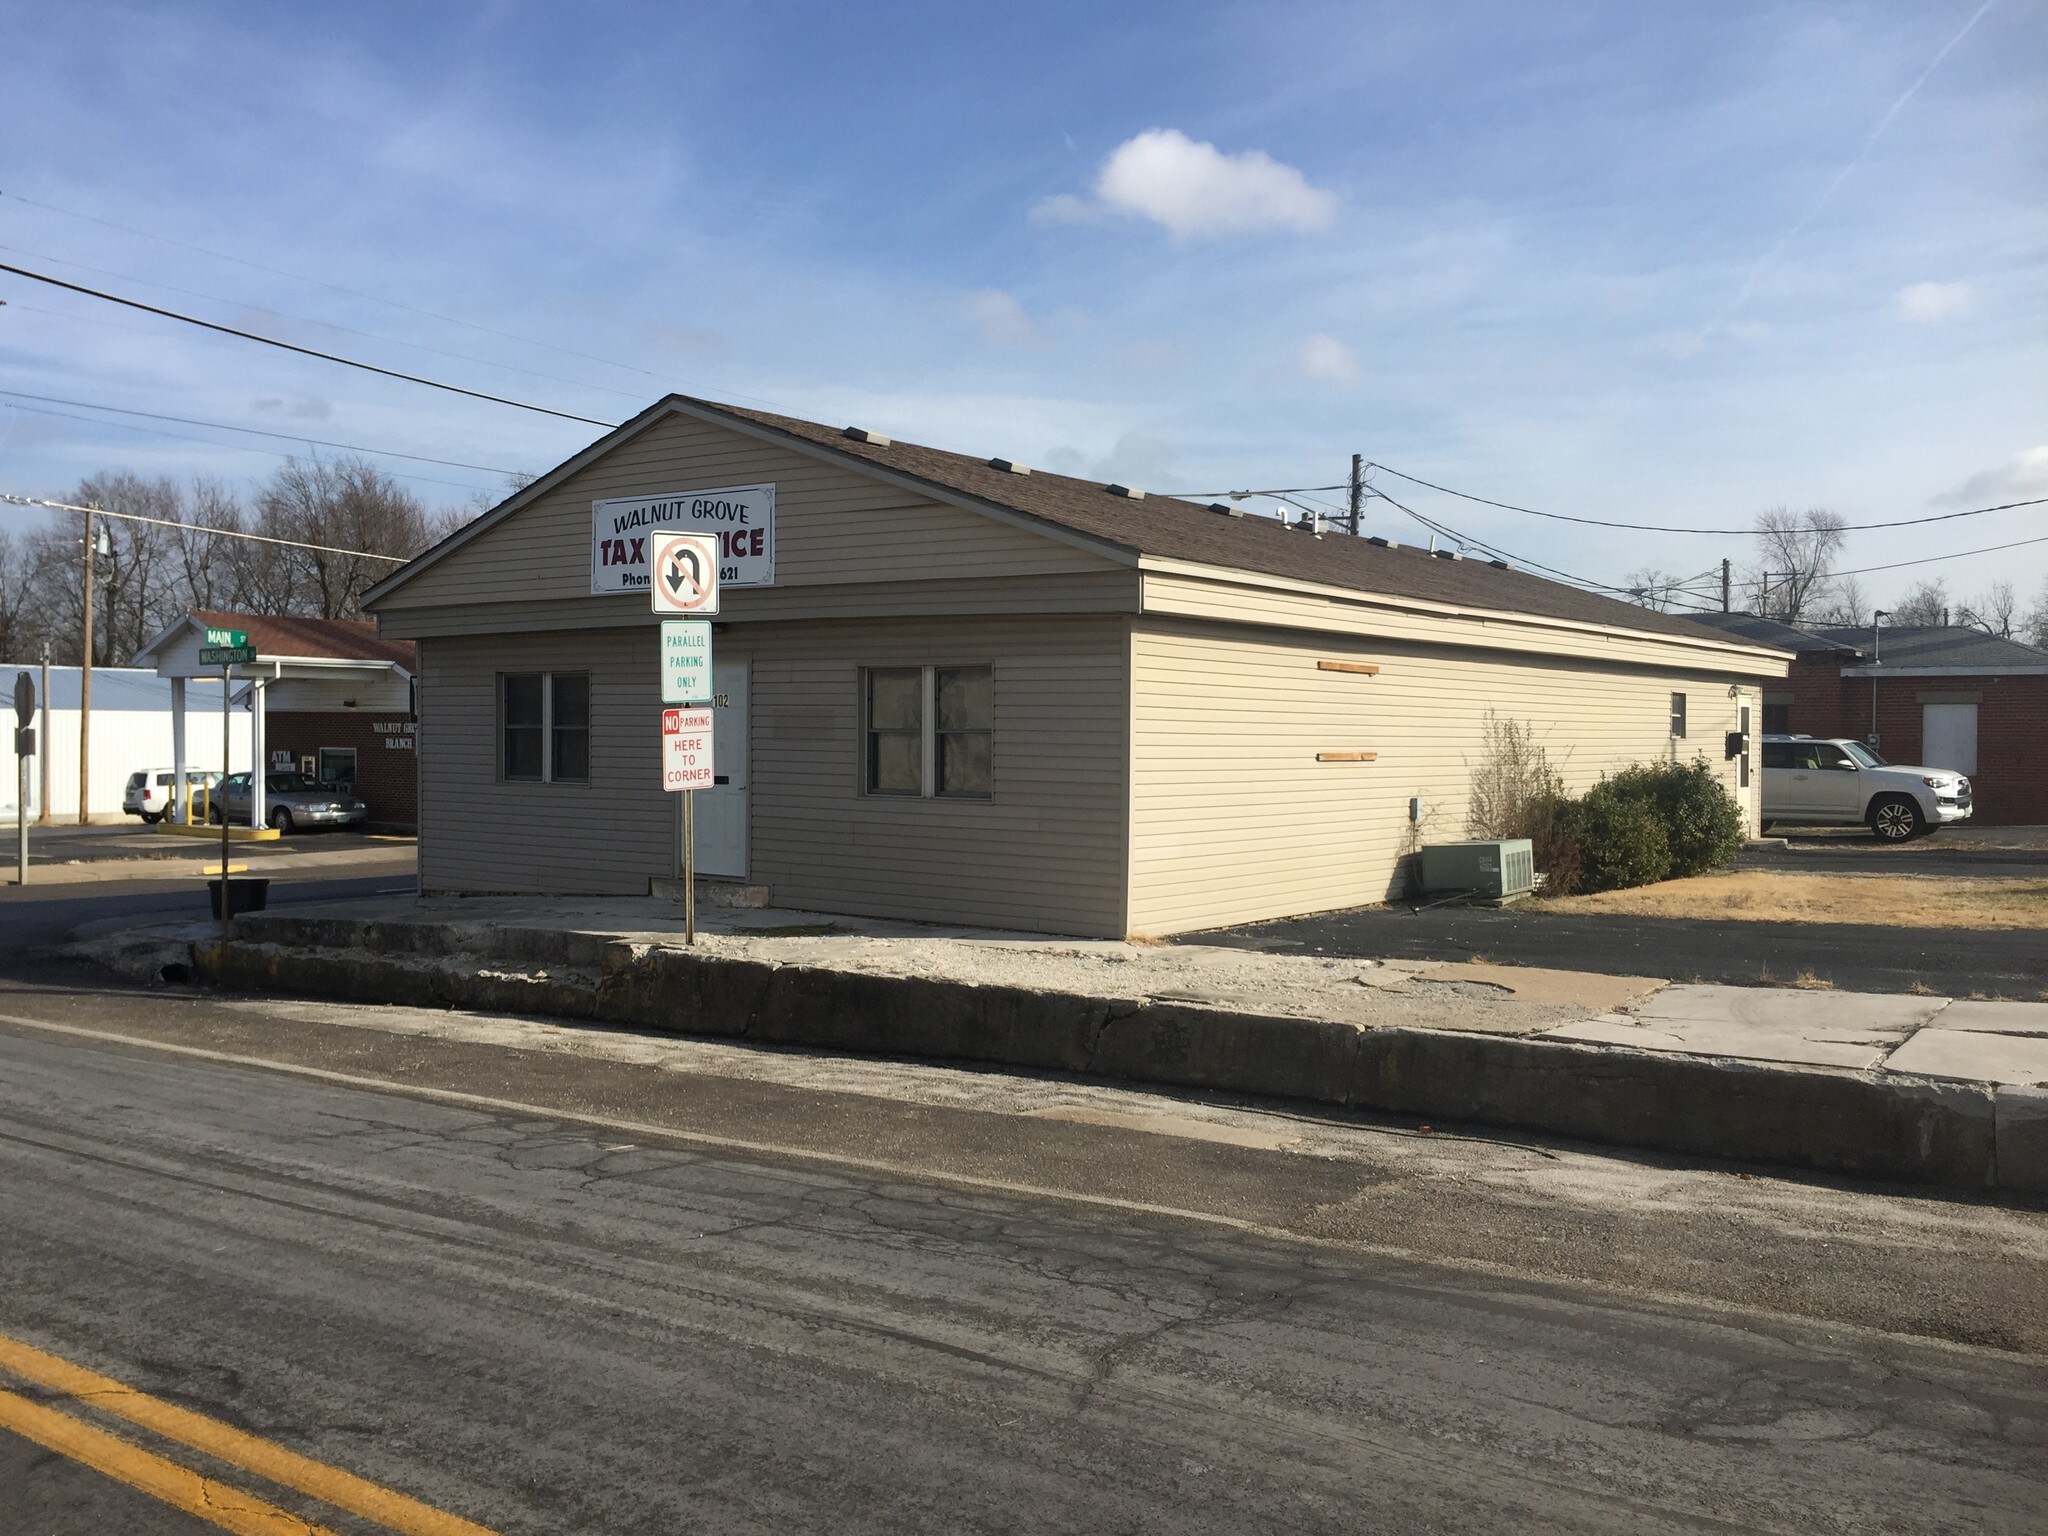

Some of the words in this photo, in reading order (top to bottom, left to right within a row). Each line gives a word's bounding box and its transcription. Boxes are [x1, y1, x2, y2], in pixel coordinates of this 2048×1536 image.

[614, 501, 685, 534] WALNUT
[691, 499, 750, 525] GROVE
[600, 537, 645, 566] TAX
[622, 571, 650, 586] Phon
[208, 630, 231, 644] MAIN
[667, 635, 706, 648] PARALLEL
[201, 649, 248, 663] WASHINGTON
[670, 656, 704, 668] PARKING
[677, 676, 697, 688] ONLY
[713, 694, 729, 708] 102
[373, 723, 401, 733] WALNUT
[665, 715, 679, 731] NO
[680, 716, 710, 728] PARKING
[385, 738, 413, 749] BRANCH
[674, 739, 703, 752] HERE
[271, 750, 291, 763] ATM
[682, 754, 696, 766] TO
[667, 768, 711, 783] CORNER
